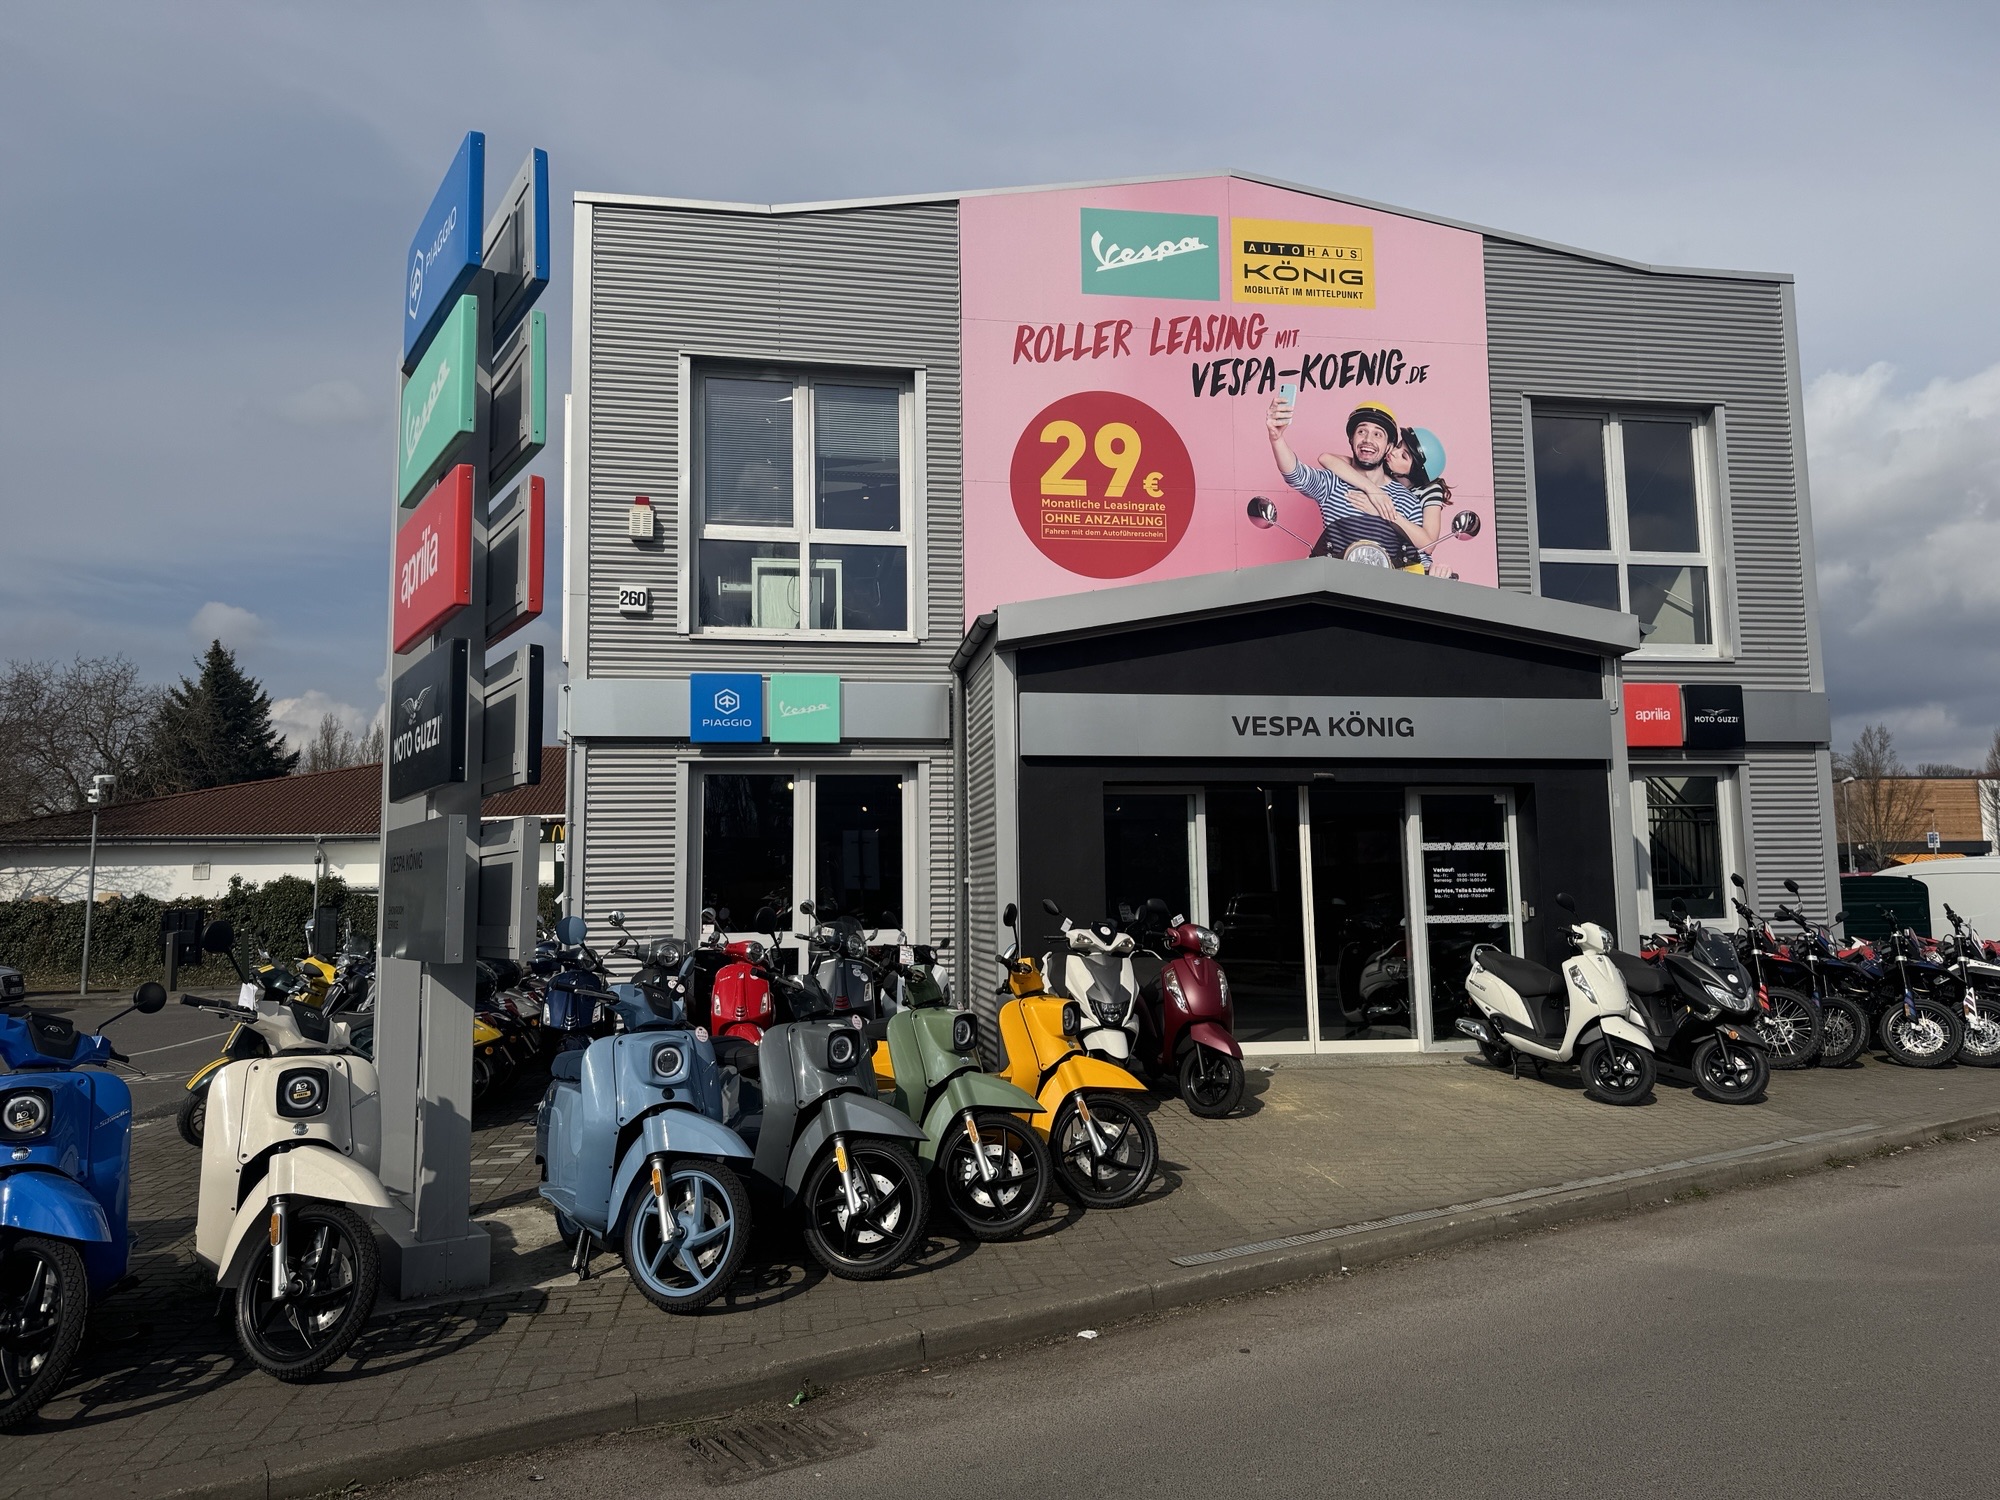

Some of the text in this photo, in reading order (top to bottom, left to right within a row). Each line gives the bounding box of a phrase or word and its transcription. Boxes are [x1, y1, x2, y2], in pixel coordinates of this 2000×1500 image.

[425, 206, 457, 274] PIAGGIO
[1091, 230, 1209, 272] Vespa
[1247, 243, 1358, 259] AUTOHAUS
[1244, 260, 1364, 286] KÖNIG
[1244, 285, 1364, 300] MOBILITÄT IM MITTELPUNKT
[1012, 319, 1133, 365] ROLLER
[1149, 313, 1269, 356] LEASING
[405, 358, 450, 469] Vespa
[1041, 498, 1166, 513] Monatliche Leasingrate
[1044, 513, 1164, 527] OHNE ANZAHLUNG
[1071, 528, 1083, 536] mit
[1085, 529, 1101, 537] dem
[1102, 529, 1164, 538] Autoführerschein
[401, 524, 439, 609] aprilia
[620, 590, 646, 607] 260
[779, 700, 830, 718] Vespa
[1635, 707, 1671, 723] aprilia
[702, 718, 752, 728] PIAGGIO
[1231, 710, 1415, 738] VESPA KÖNIG
[1694, 715, 1739, 723] MOTO GUZZI
[393, 715, 440, 765] MOTO GUZZI
